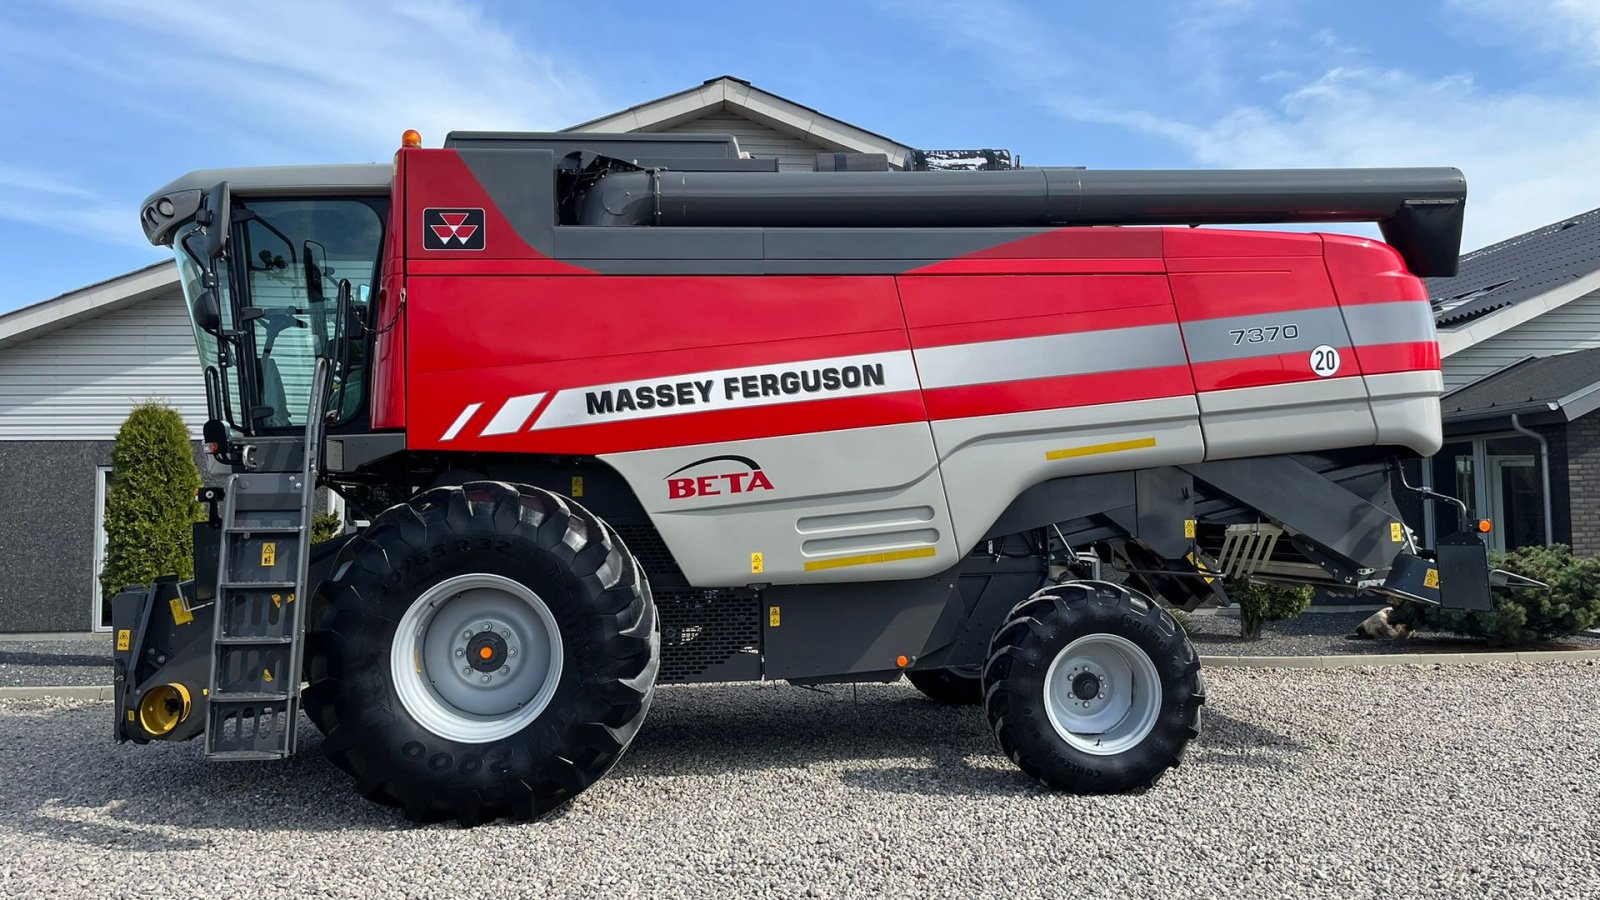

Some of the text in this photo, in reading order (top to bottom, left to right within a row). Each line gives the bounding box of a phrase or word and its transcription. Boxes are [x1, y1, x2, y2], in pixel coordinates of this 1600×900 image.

[1228, 324, 1299, 346] 7370
[1315, 350, 1336, 371] 20
[585, 363, 886, 416] MASSEY FERGUSON
[667, 470, 775, 500] BETA
